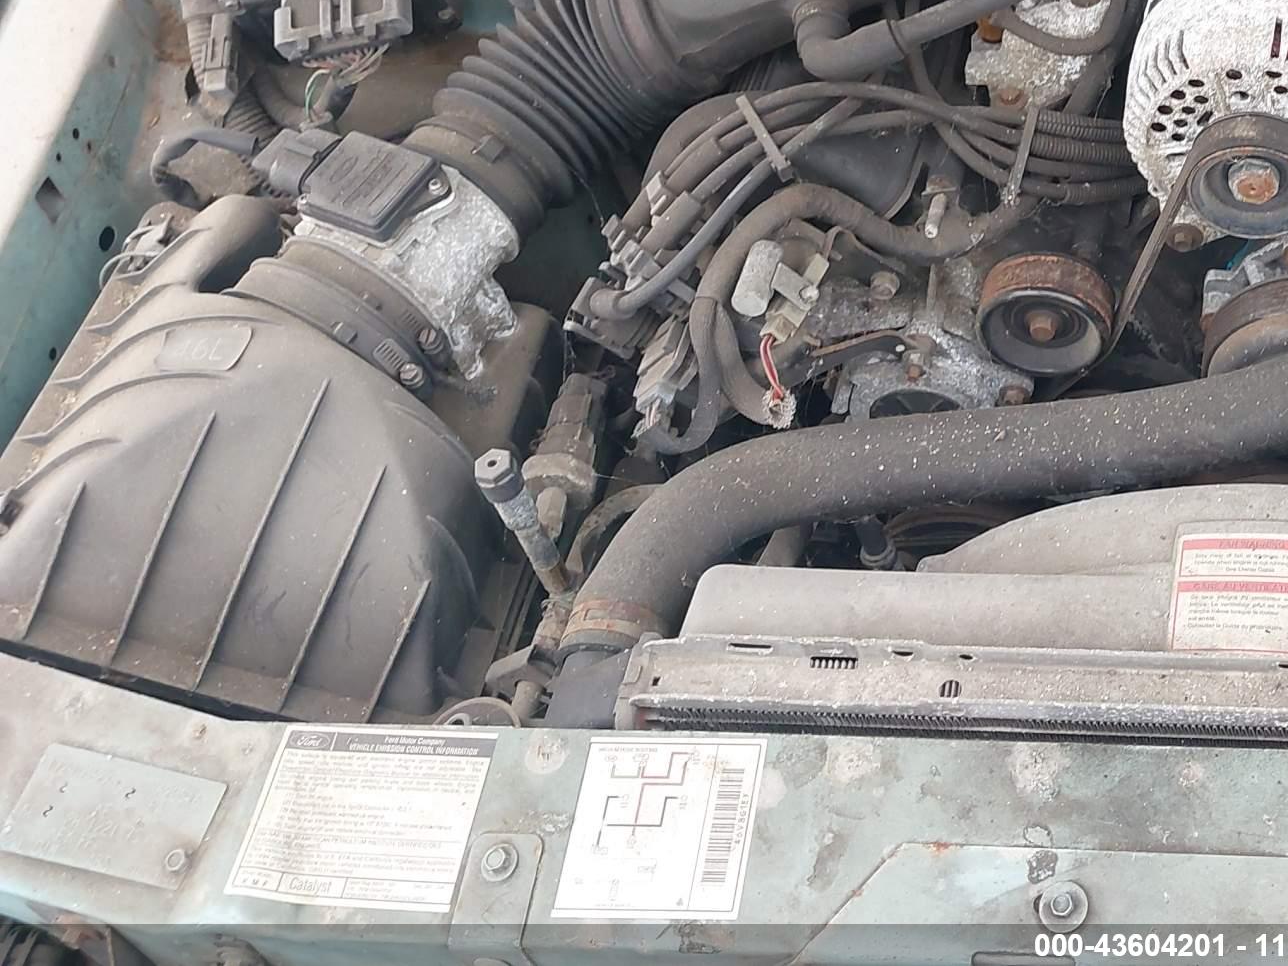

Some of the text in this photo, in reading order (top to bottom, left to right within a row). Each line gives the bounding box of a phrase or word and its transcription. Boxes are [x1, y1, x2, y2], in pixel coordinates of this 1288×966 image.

[295, 734, 323, 747] Ford
[384, 736, 446, 746] Ford Motor Company
[349, 743, 479, 755] VEHICLE EMISSION CONTROL INFORMATION
[288, 876, 332, 895] Catalyst
